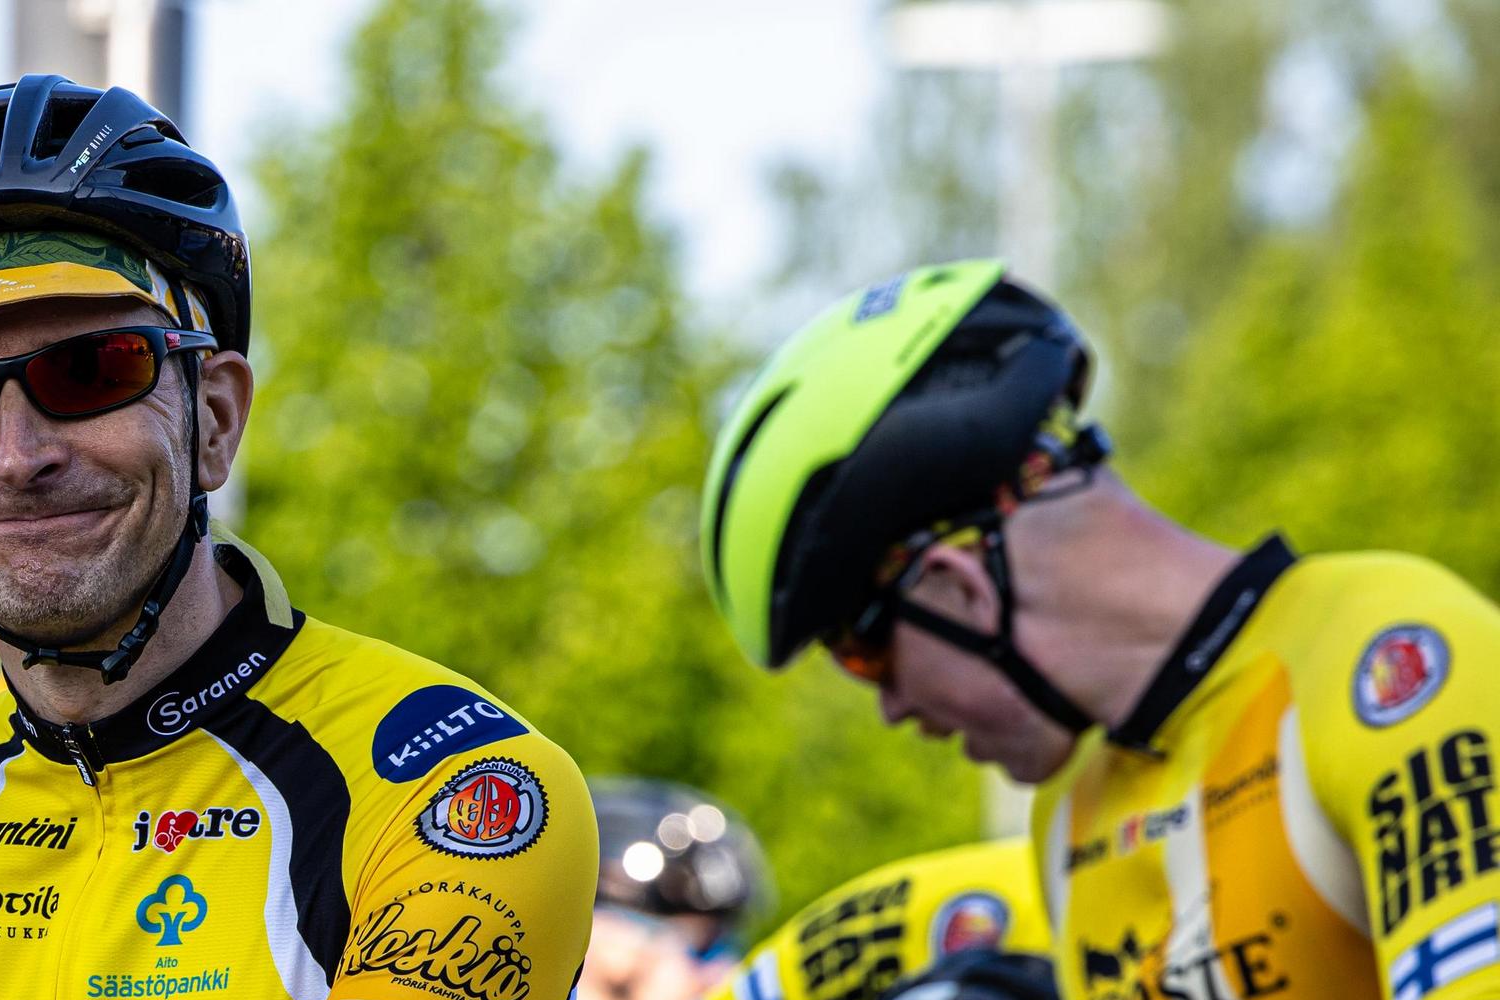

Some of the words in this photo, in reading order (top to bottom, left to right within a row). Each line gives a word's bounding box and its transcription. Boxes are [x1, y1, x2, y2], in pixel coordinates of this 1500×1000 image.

[70, 147, 90, 173] MET
[158, 651, 267, 727] Saranen
[156, 956, 178, 969] Aito
[87, 967, 230, 999] Säästöpankki
[391, 976, 429, 991] PYÖRIÄ
